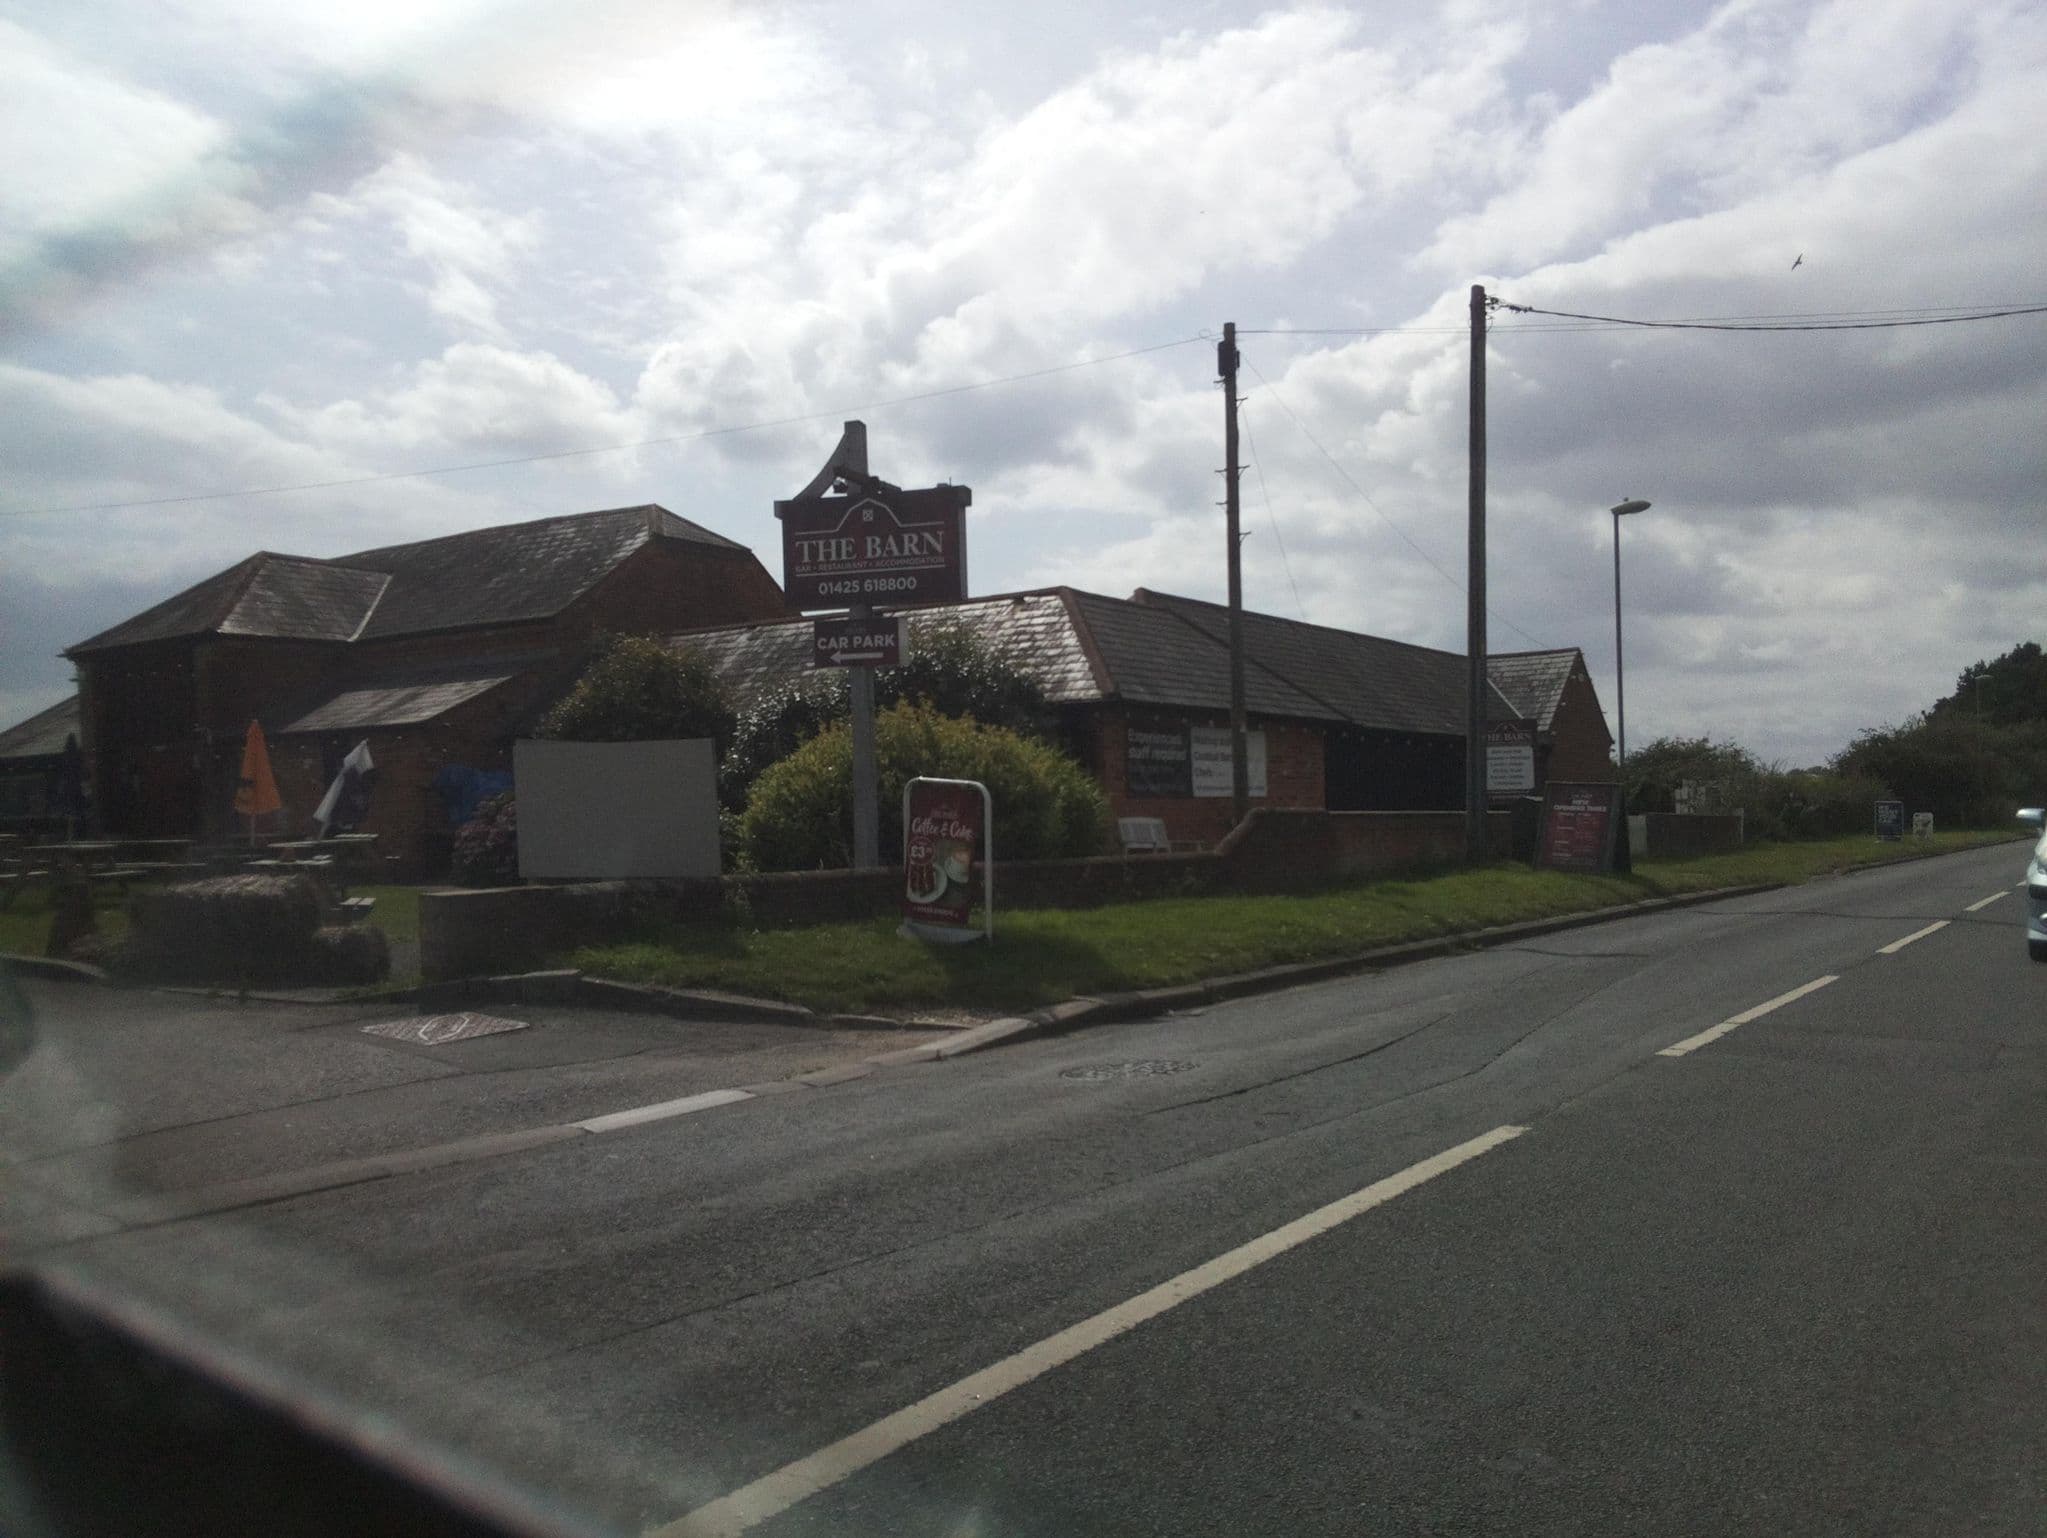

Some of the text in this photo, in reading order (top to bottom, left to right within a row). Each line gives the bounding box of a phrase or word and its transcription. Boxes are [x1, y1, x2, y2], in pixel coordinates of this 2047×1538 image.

[795, 530, 945, 563] THE BARN
[818, 560, 868, 571] RESTAURANT
[875, 555, 945, 568] ACCOMMODATION
[818, 576, 917, 596] 01425 618800
[817, 633, 895, 650] CAR PARK
[911, 816, 939, 836] Coffee
